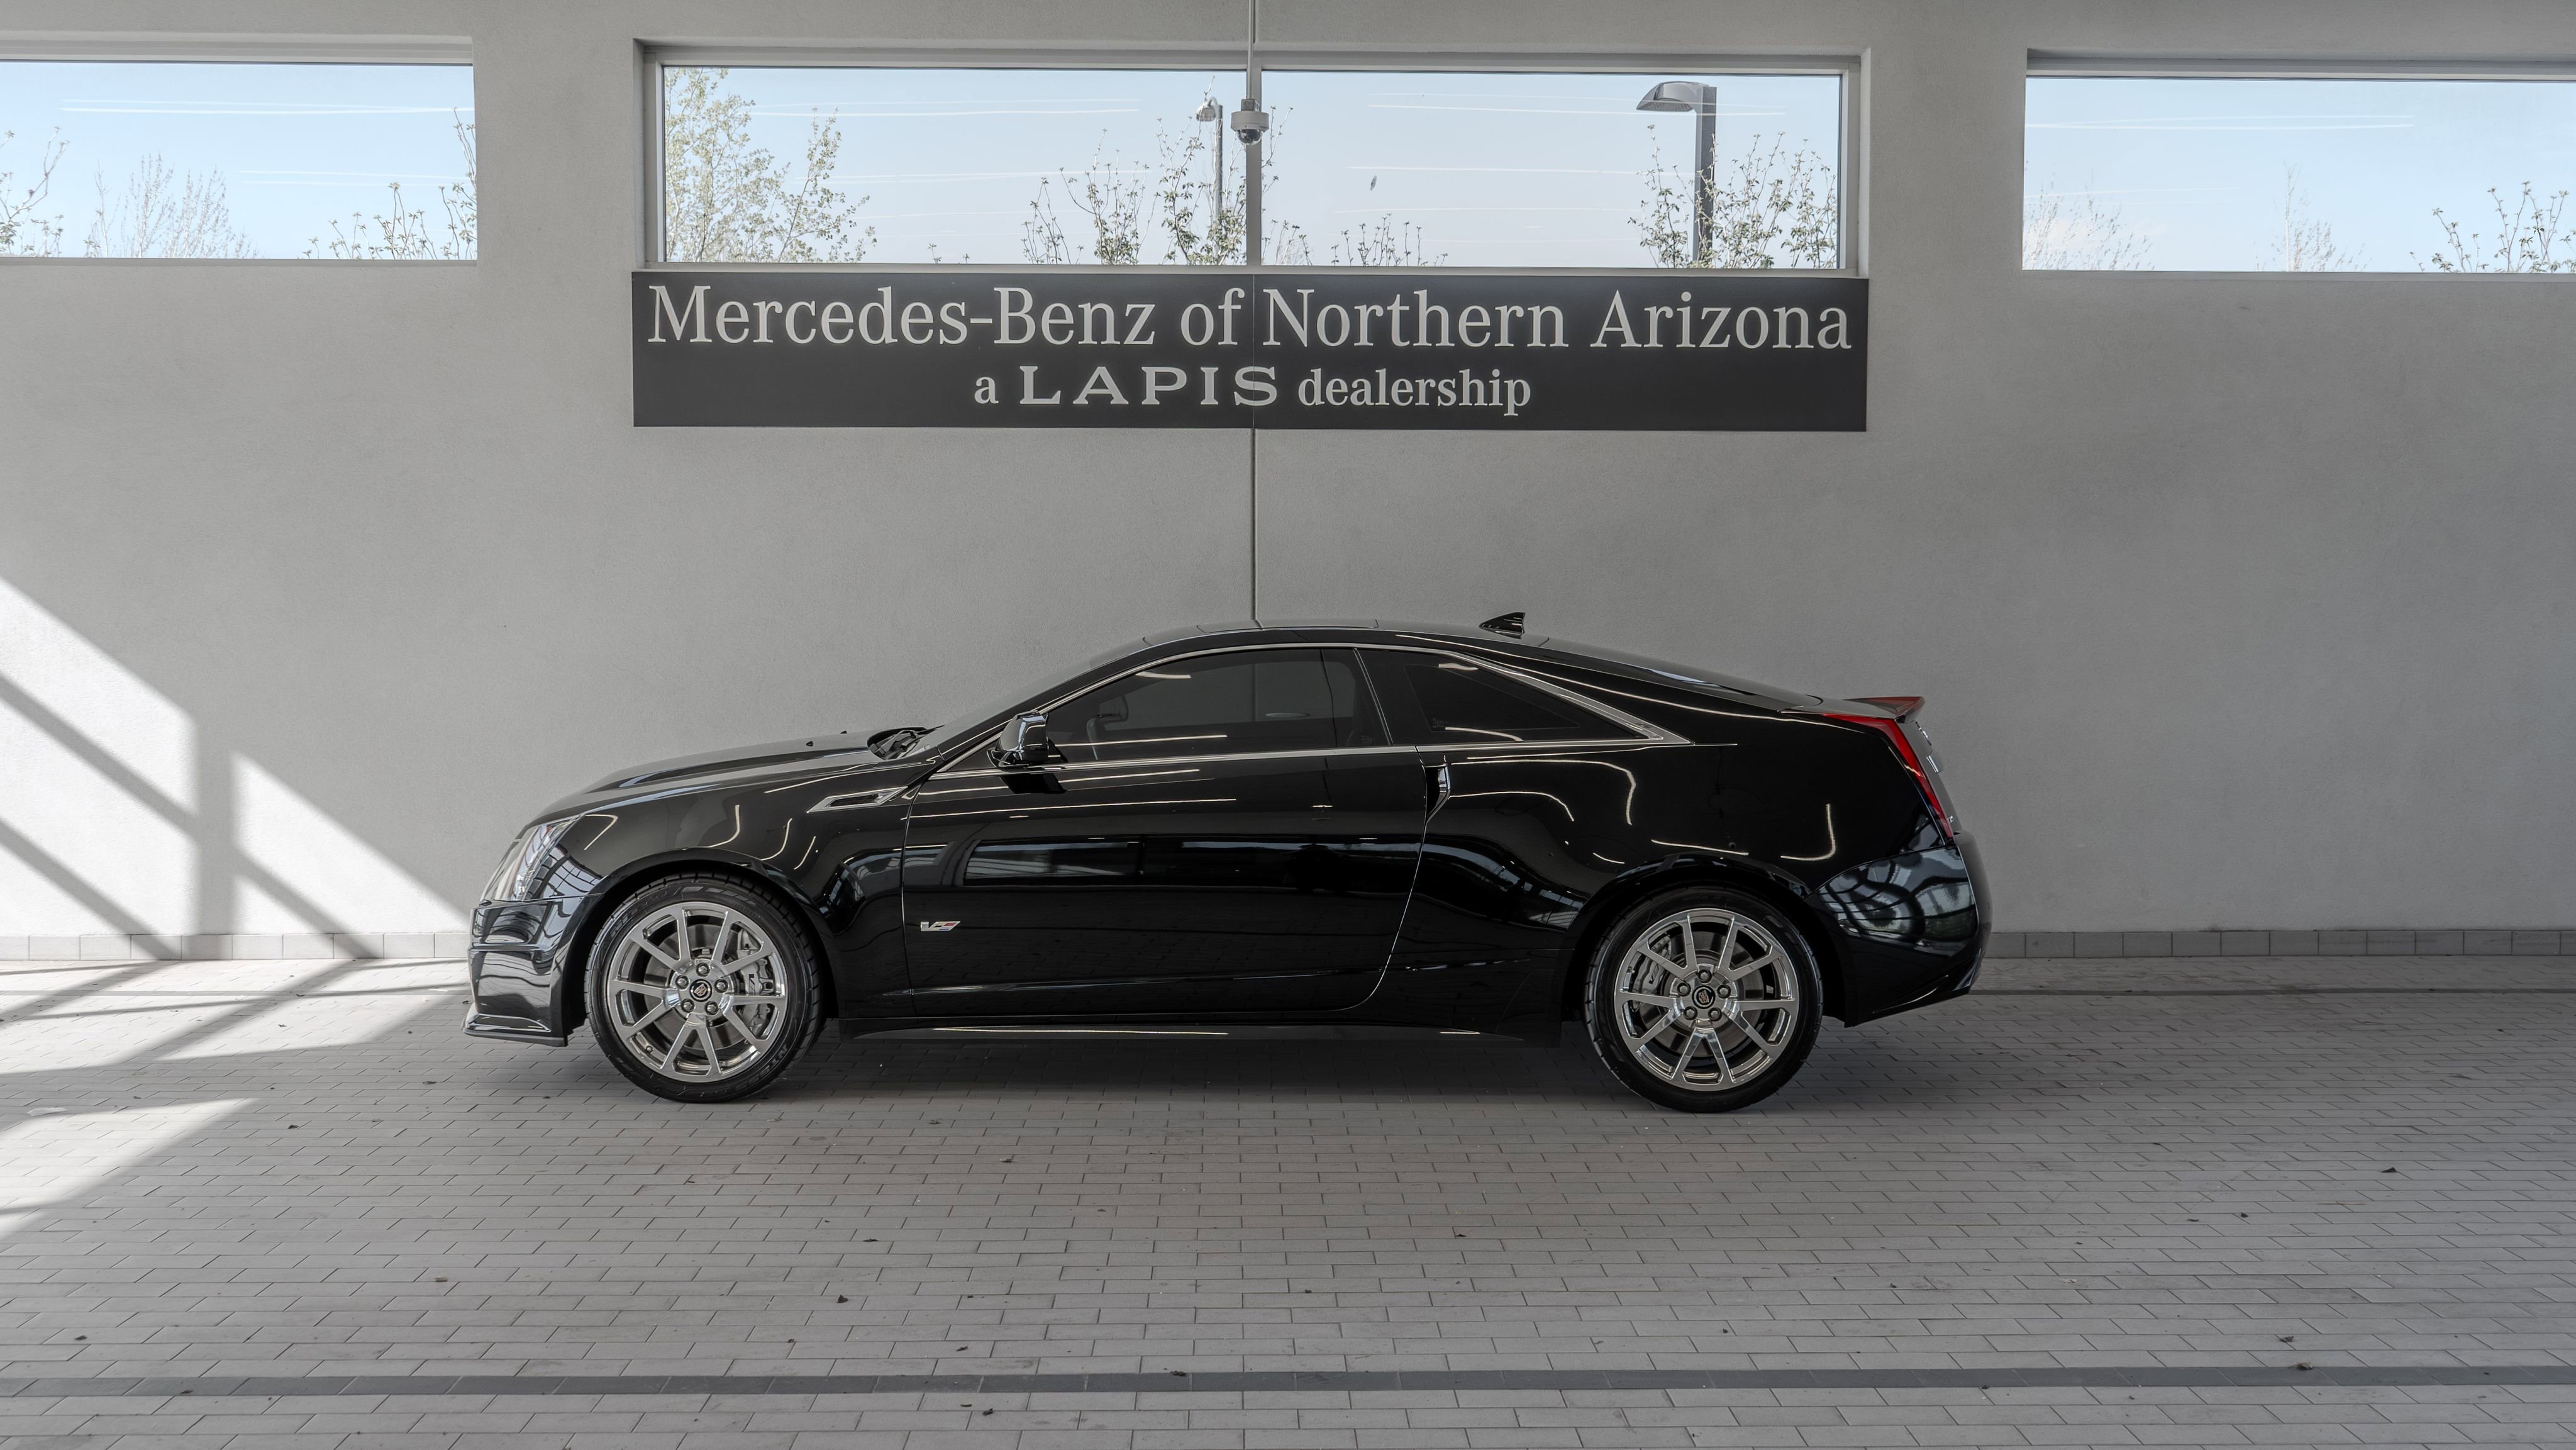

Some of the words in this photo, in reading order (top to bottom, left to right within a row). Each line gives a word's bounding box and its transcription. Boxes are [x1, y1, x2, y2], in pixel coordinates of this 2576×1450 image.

[648, 285, 1156, 345] Mercedes-Benz
[1180, 287, 1245, 346] of
[1262, 288, 1569, 347] Northern
[1590, 289, 1852, 349] Arizona
[974, 376, 999, 404] a
[1019, 365, 1277, 406] LAPIS
[1298, 368, 1531, 416] dealership
